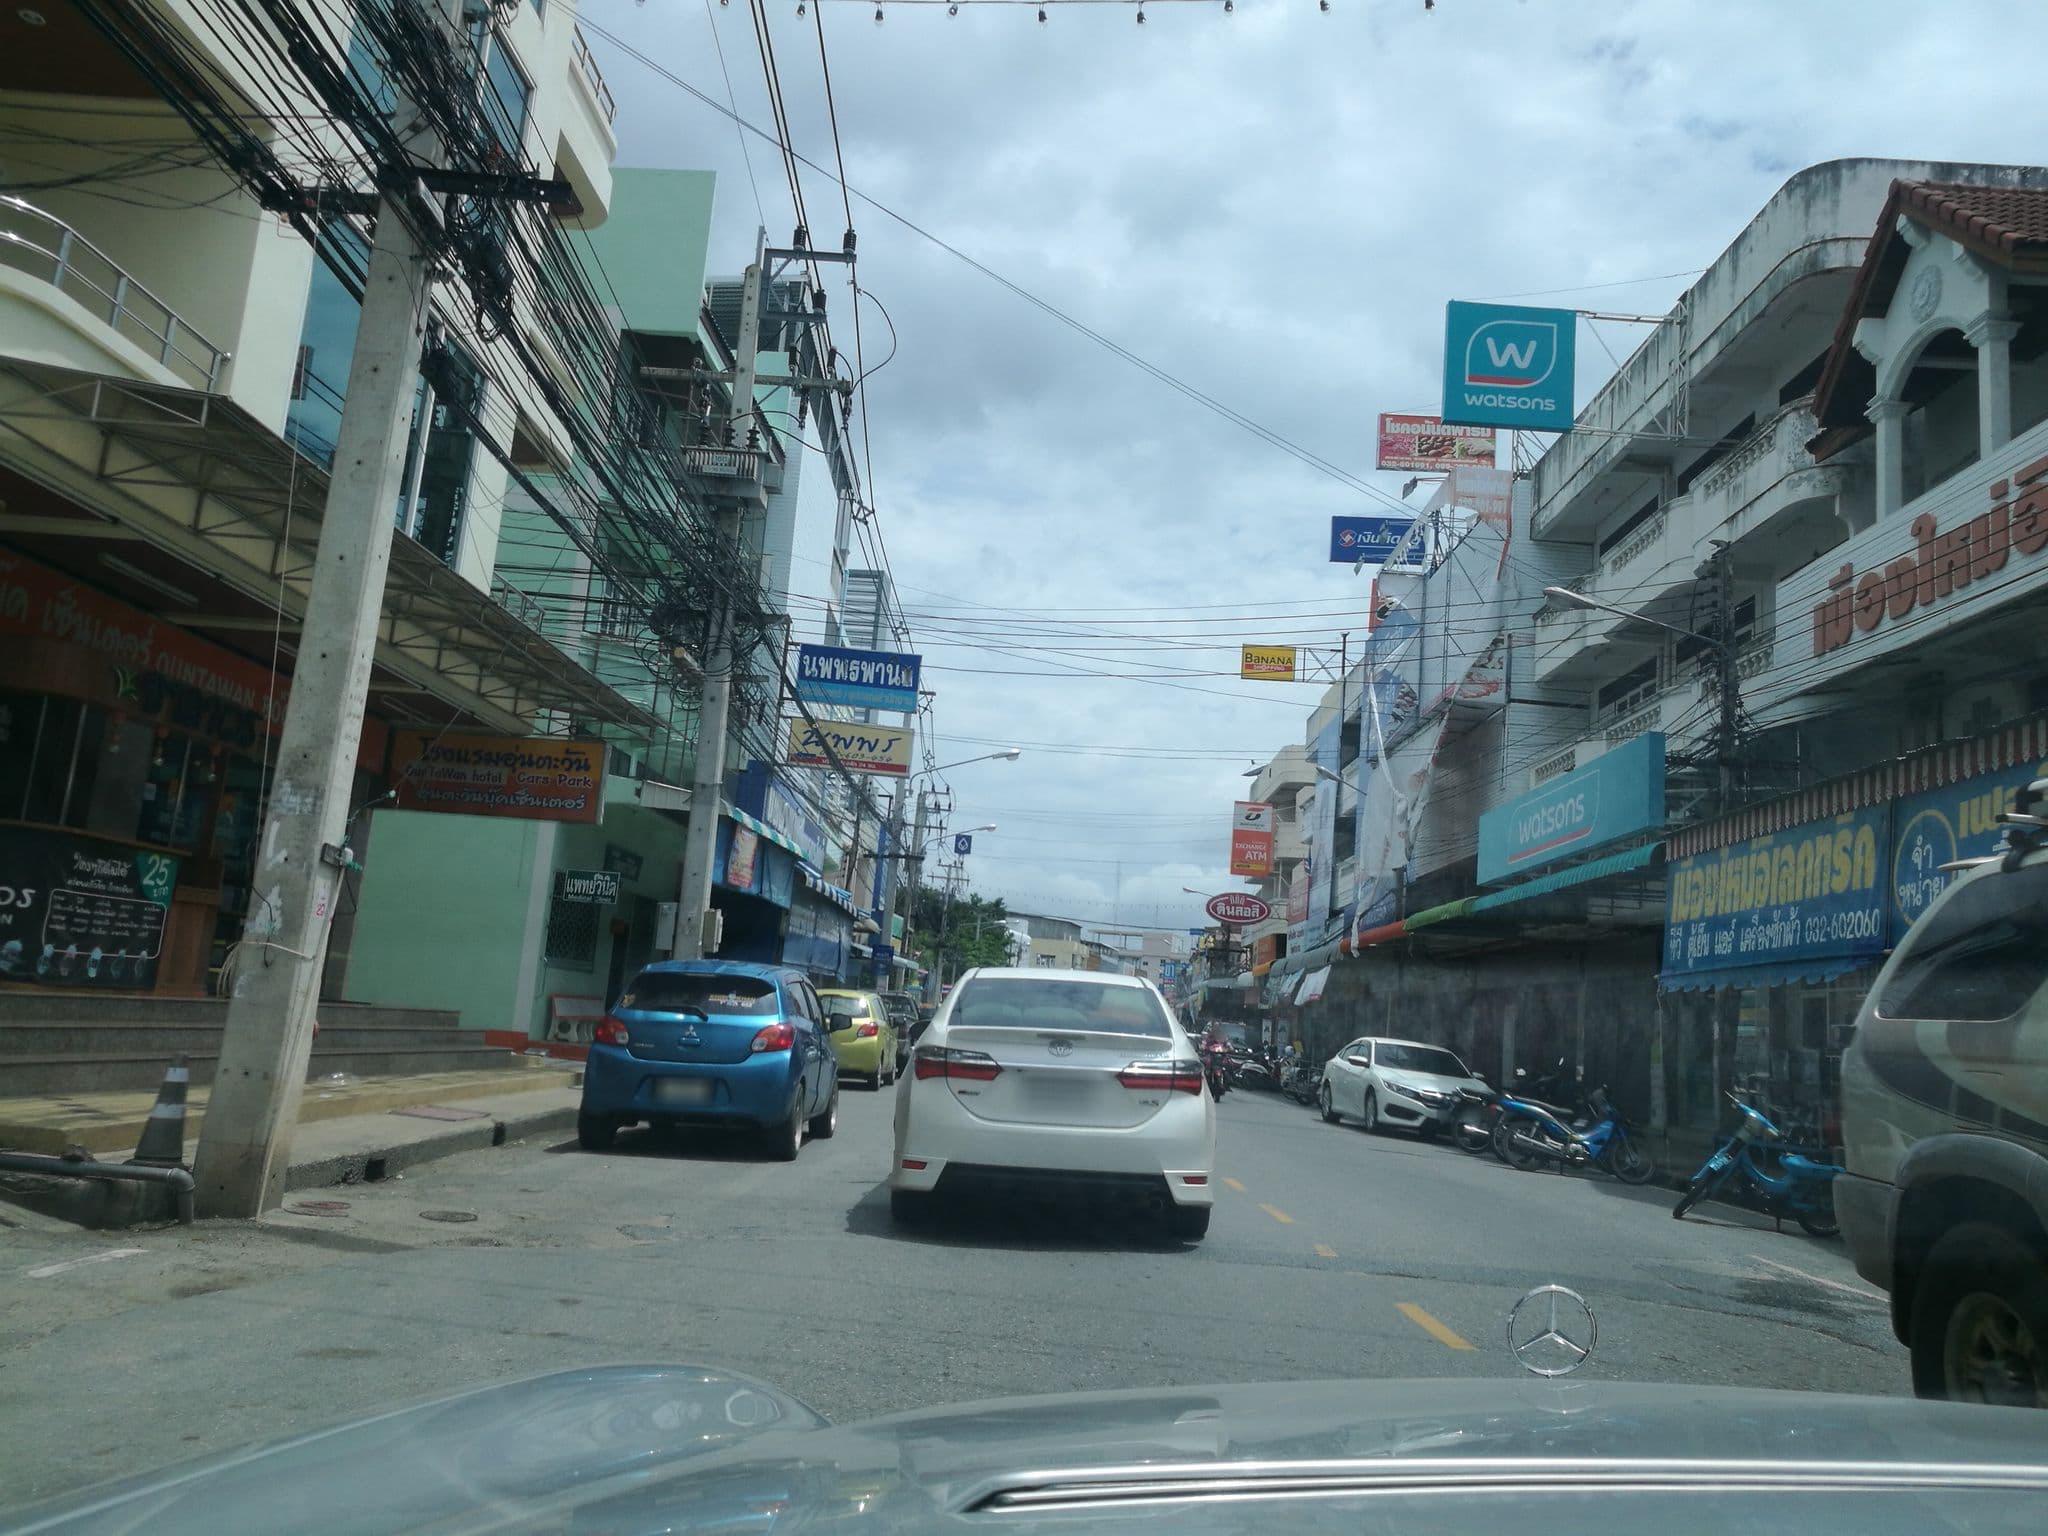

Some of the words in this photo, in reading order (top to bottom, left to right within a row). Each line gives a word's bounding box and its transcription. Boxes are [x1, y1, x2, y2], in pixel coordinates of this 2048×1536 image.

[1464, 393, 1557, 411] watsons
[556, 774, 594, 789] Park
[1519, 793, 1585, 845] watsons
[1244, 850, 1267, 861] ATM
[142, 853, 171, 887] 25
